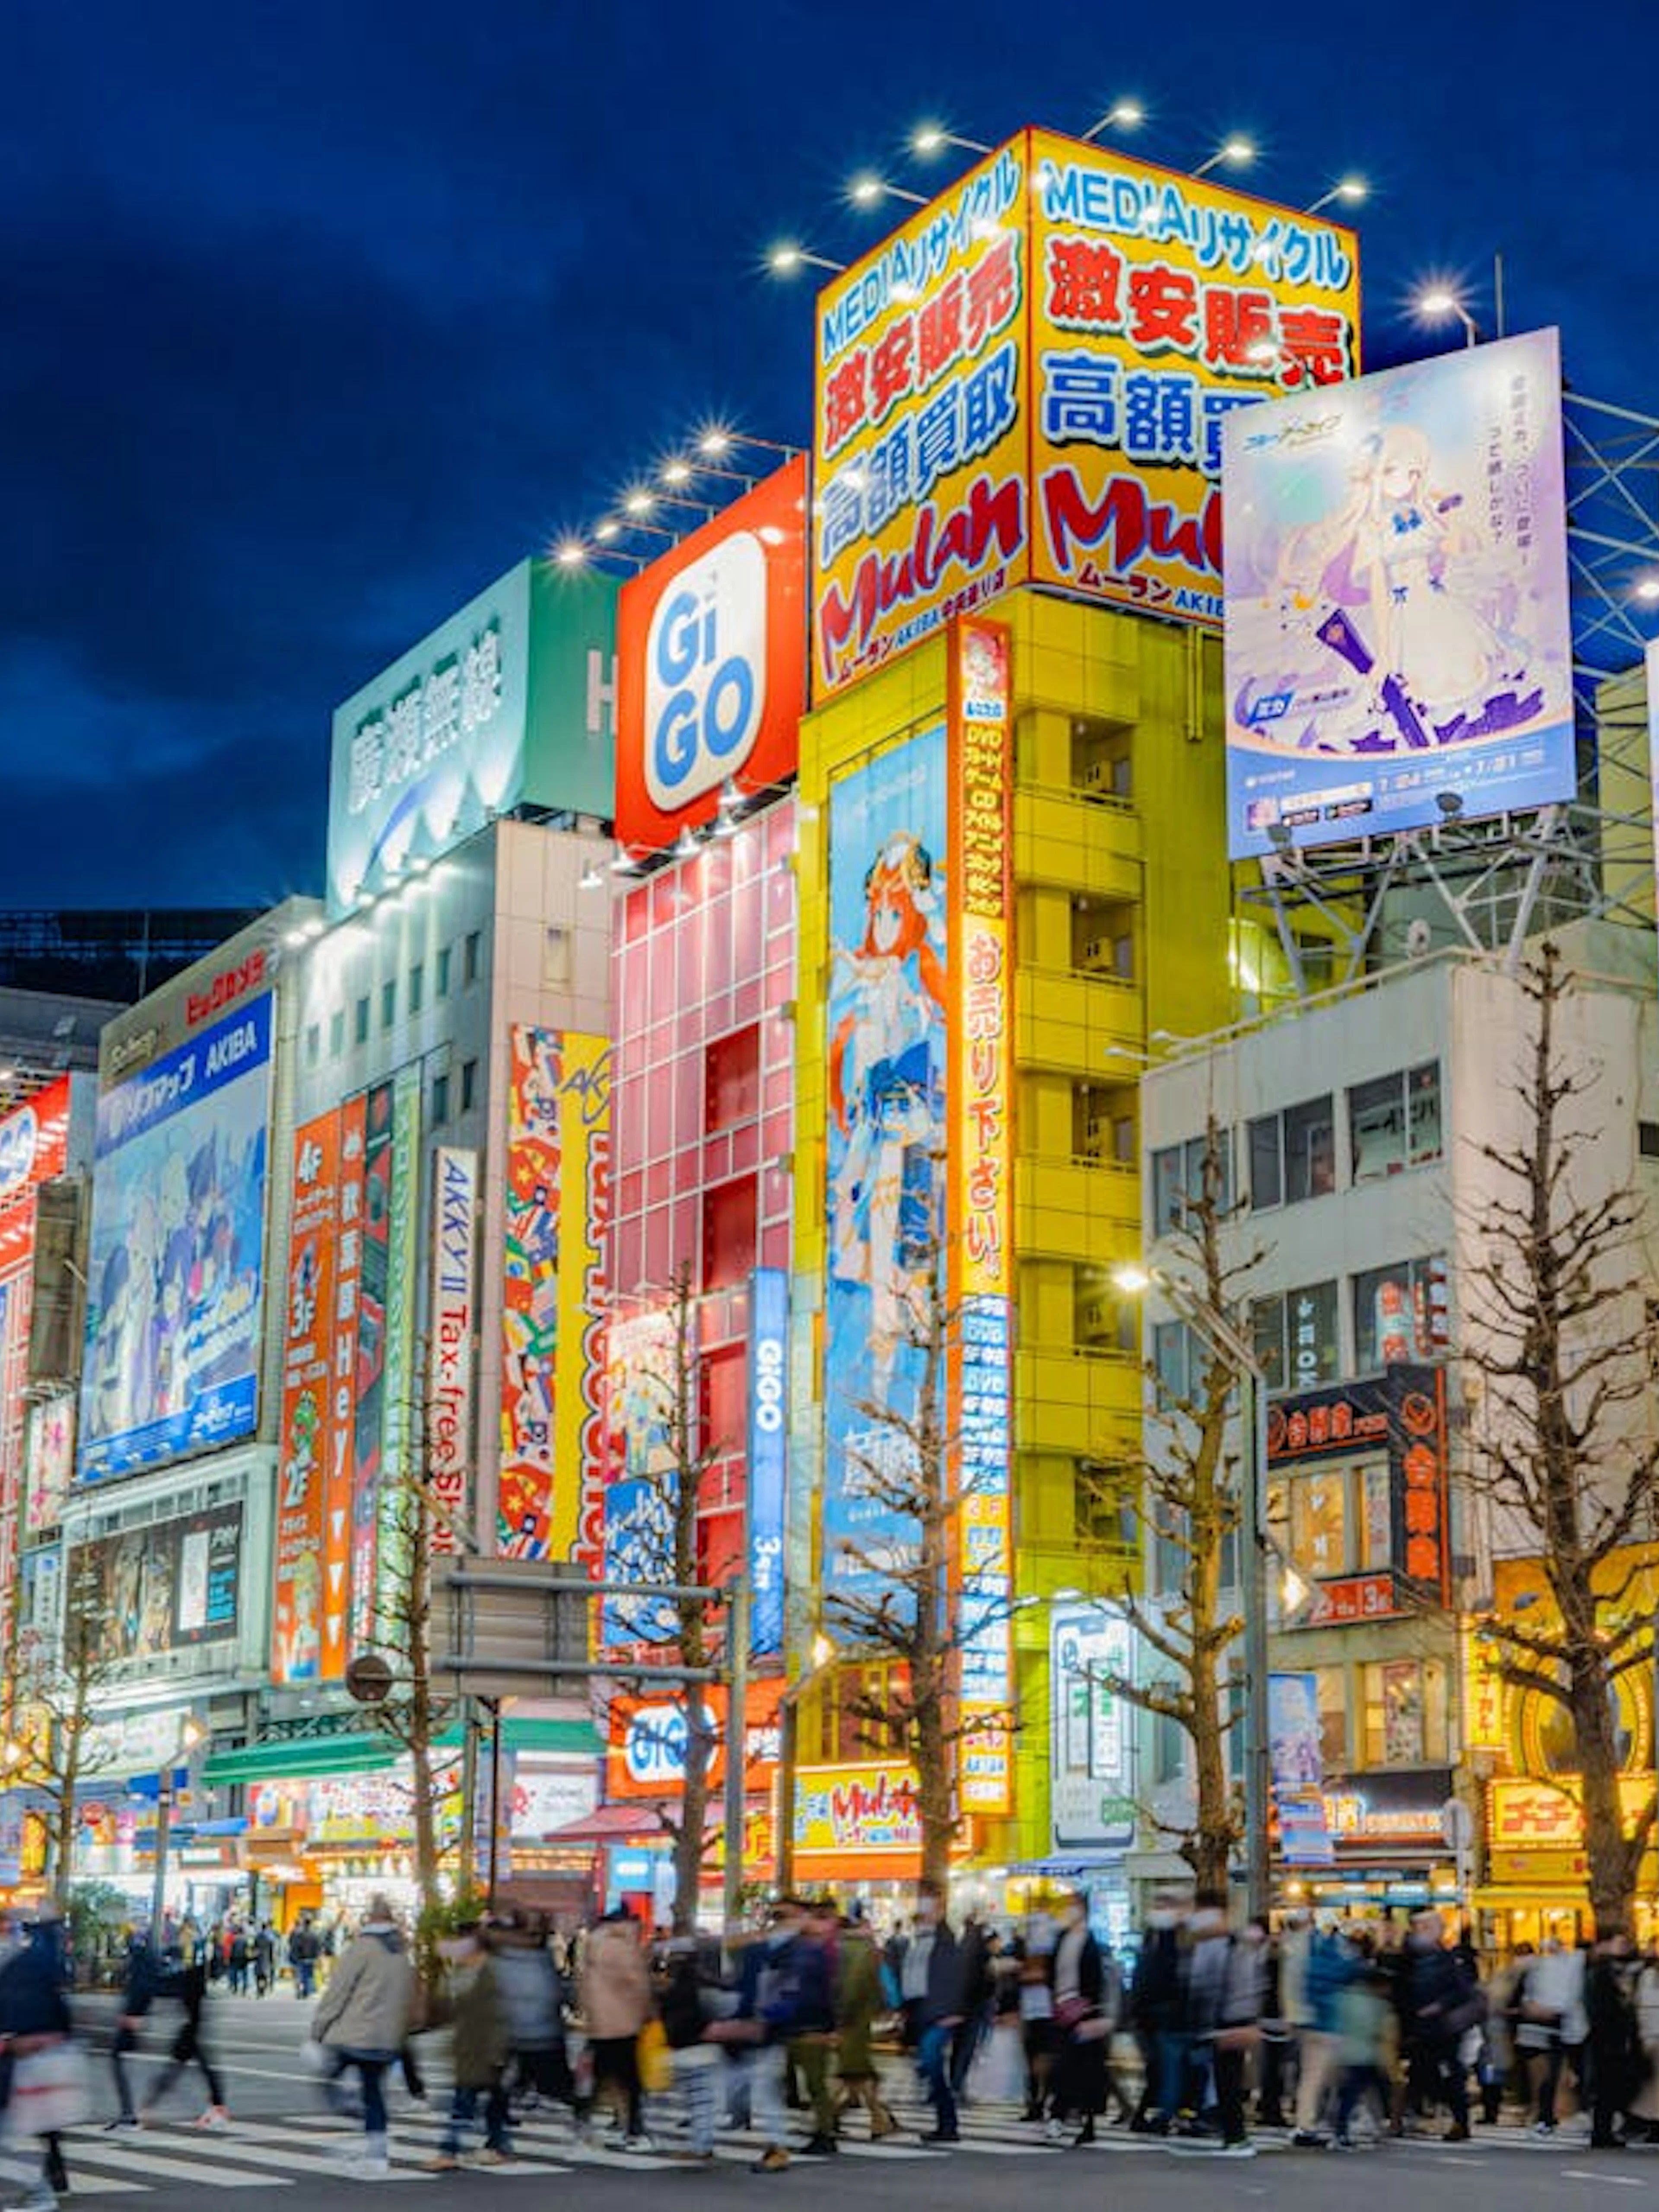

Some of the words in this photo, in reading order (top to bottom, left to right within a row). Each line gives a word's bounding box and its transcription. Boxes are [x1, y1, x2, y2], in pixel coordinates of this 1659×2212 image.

[1047, 238, 1346, 387] 激安販売
[820, 478, 1023, 680] Mulan
[1077, 561, 1173, 602] ムーラン
[205, 1020, 257, 1077] AKIBA
[438, 1304, 467, 1461] Tax-free
